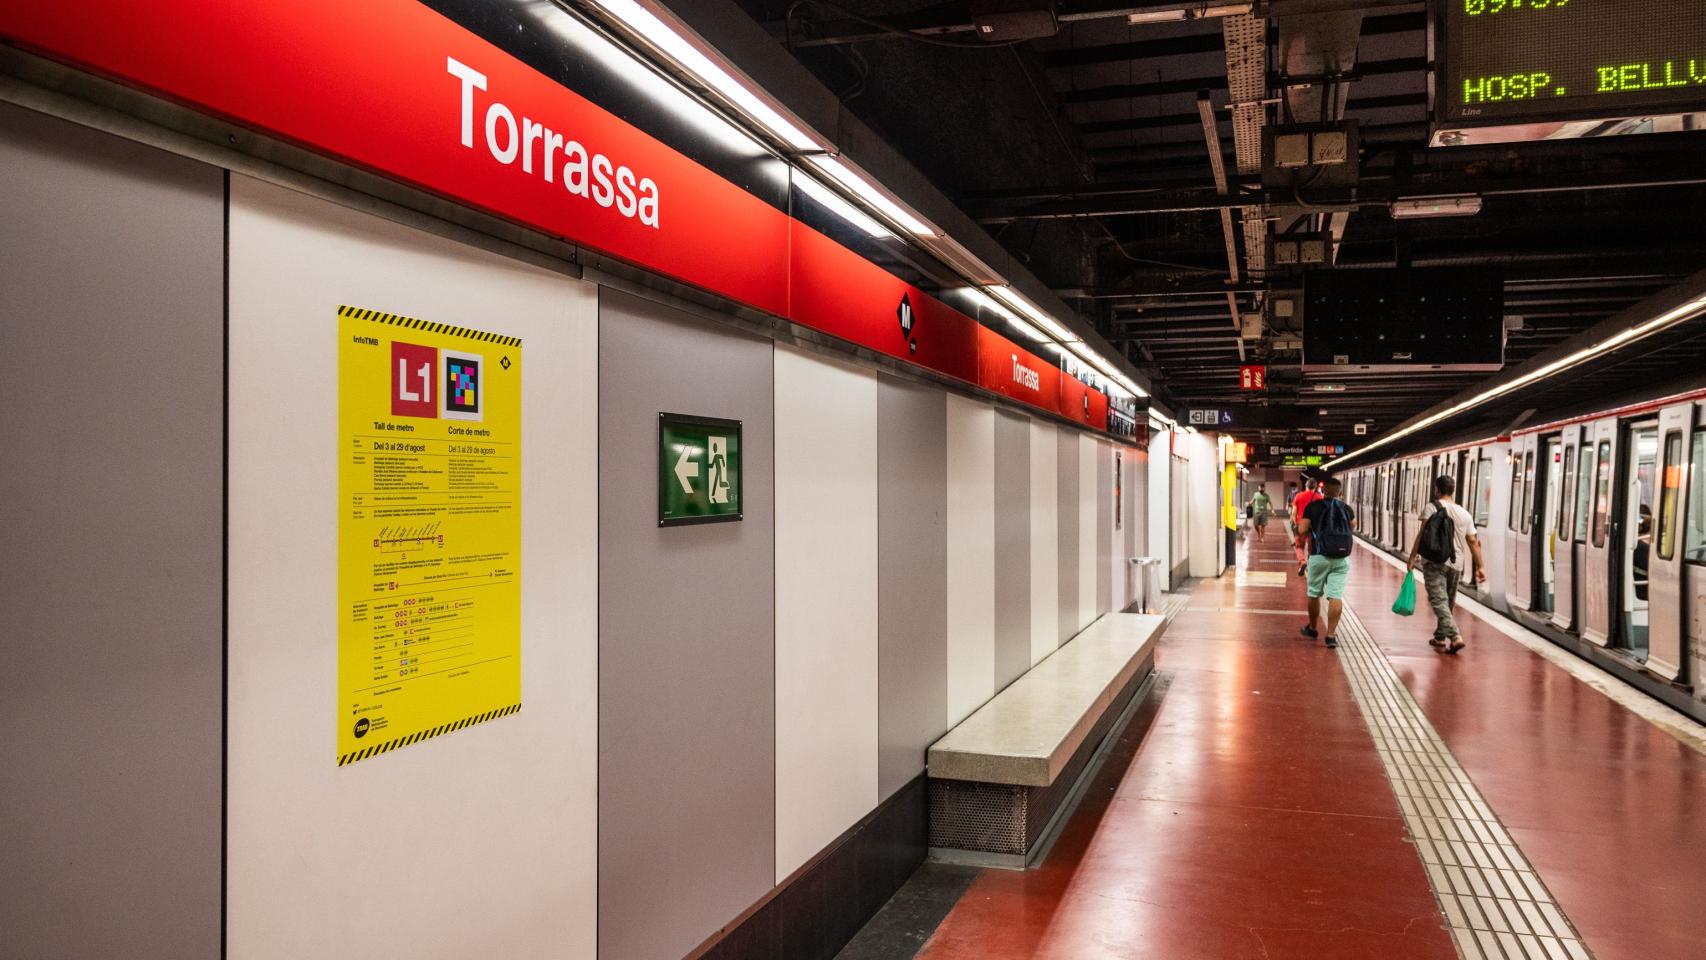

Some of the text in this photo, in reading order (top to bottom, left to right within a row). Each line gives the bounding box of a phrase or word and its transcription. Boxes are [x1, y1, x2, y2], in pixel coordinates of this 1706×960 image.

[1464, 72, 1566, 103] HOSP.
[1462, 108, 1482, 117] Line
[447, 55, 660, 230] Torrassa
[353, 336, 379, 346] InfoTMB
[1012, 354, 1039, 392] Torrassa
[399, 358, 431, 403] L1
[374, 422, 384, 430] Tall
[448, 426, 464, 434] Corte
[374, 442, 384, 450] Del
[404, 444, 426, 453] d'agost
[448, 445, 456, 453] Del
